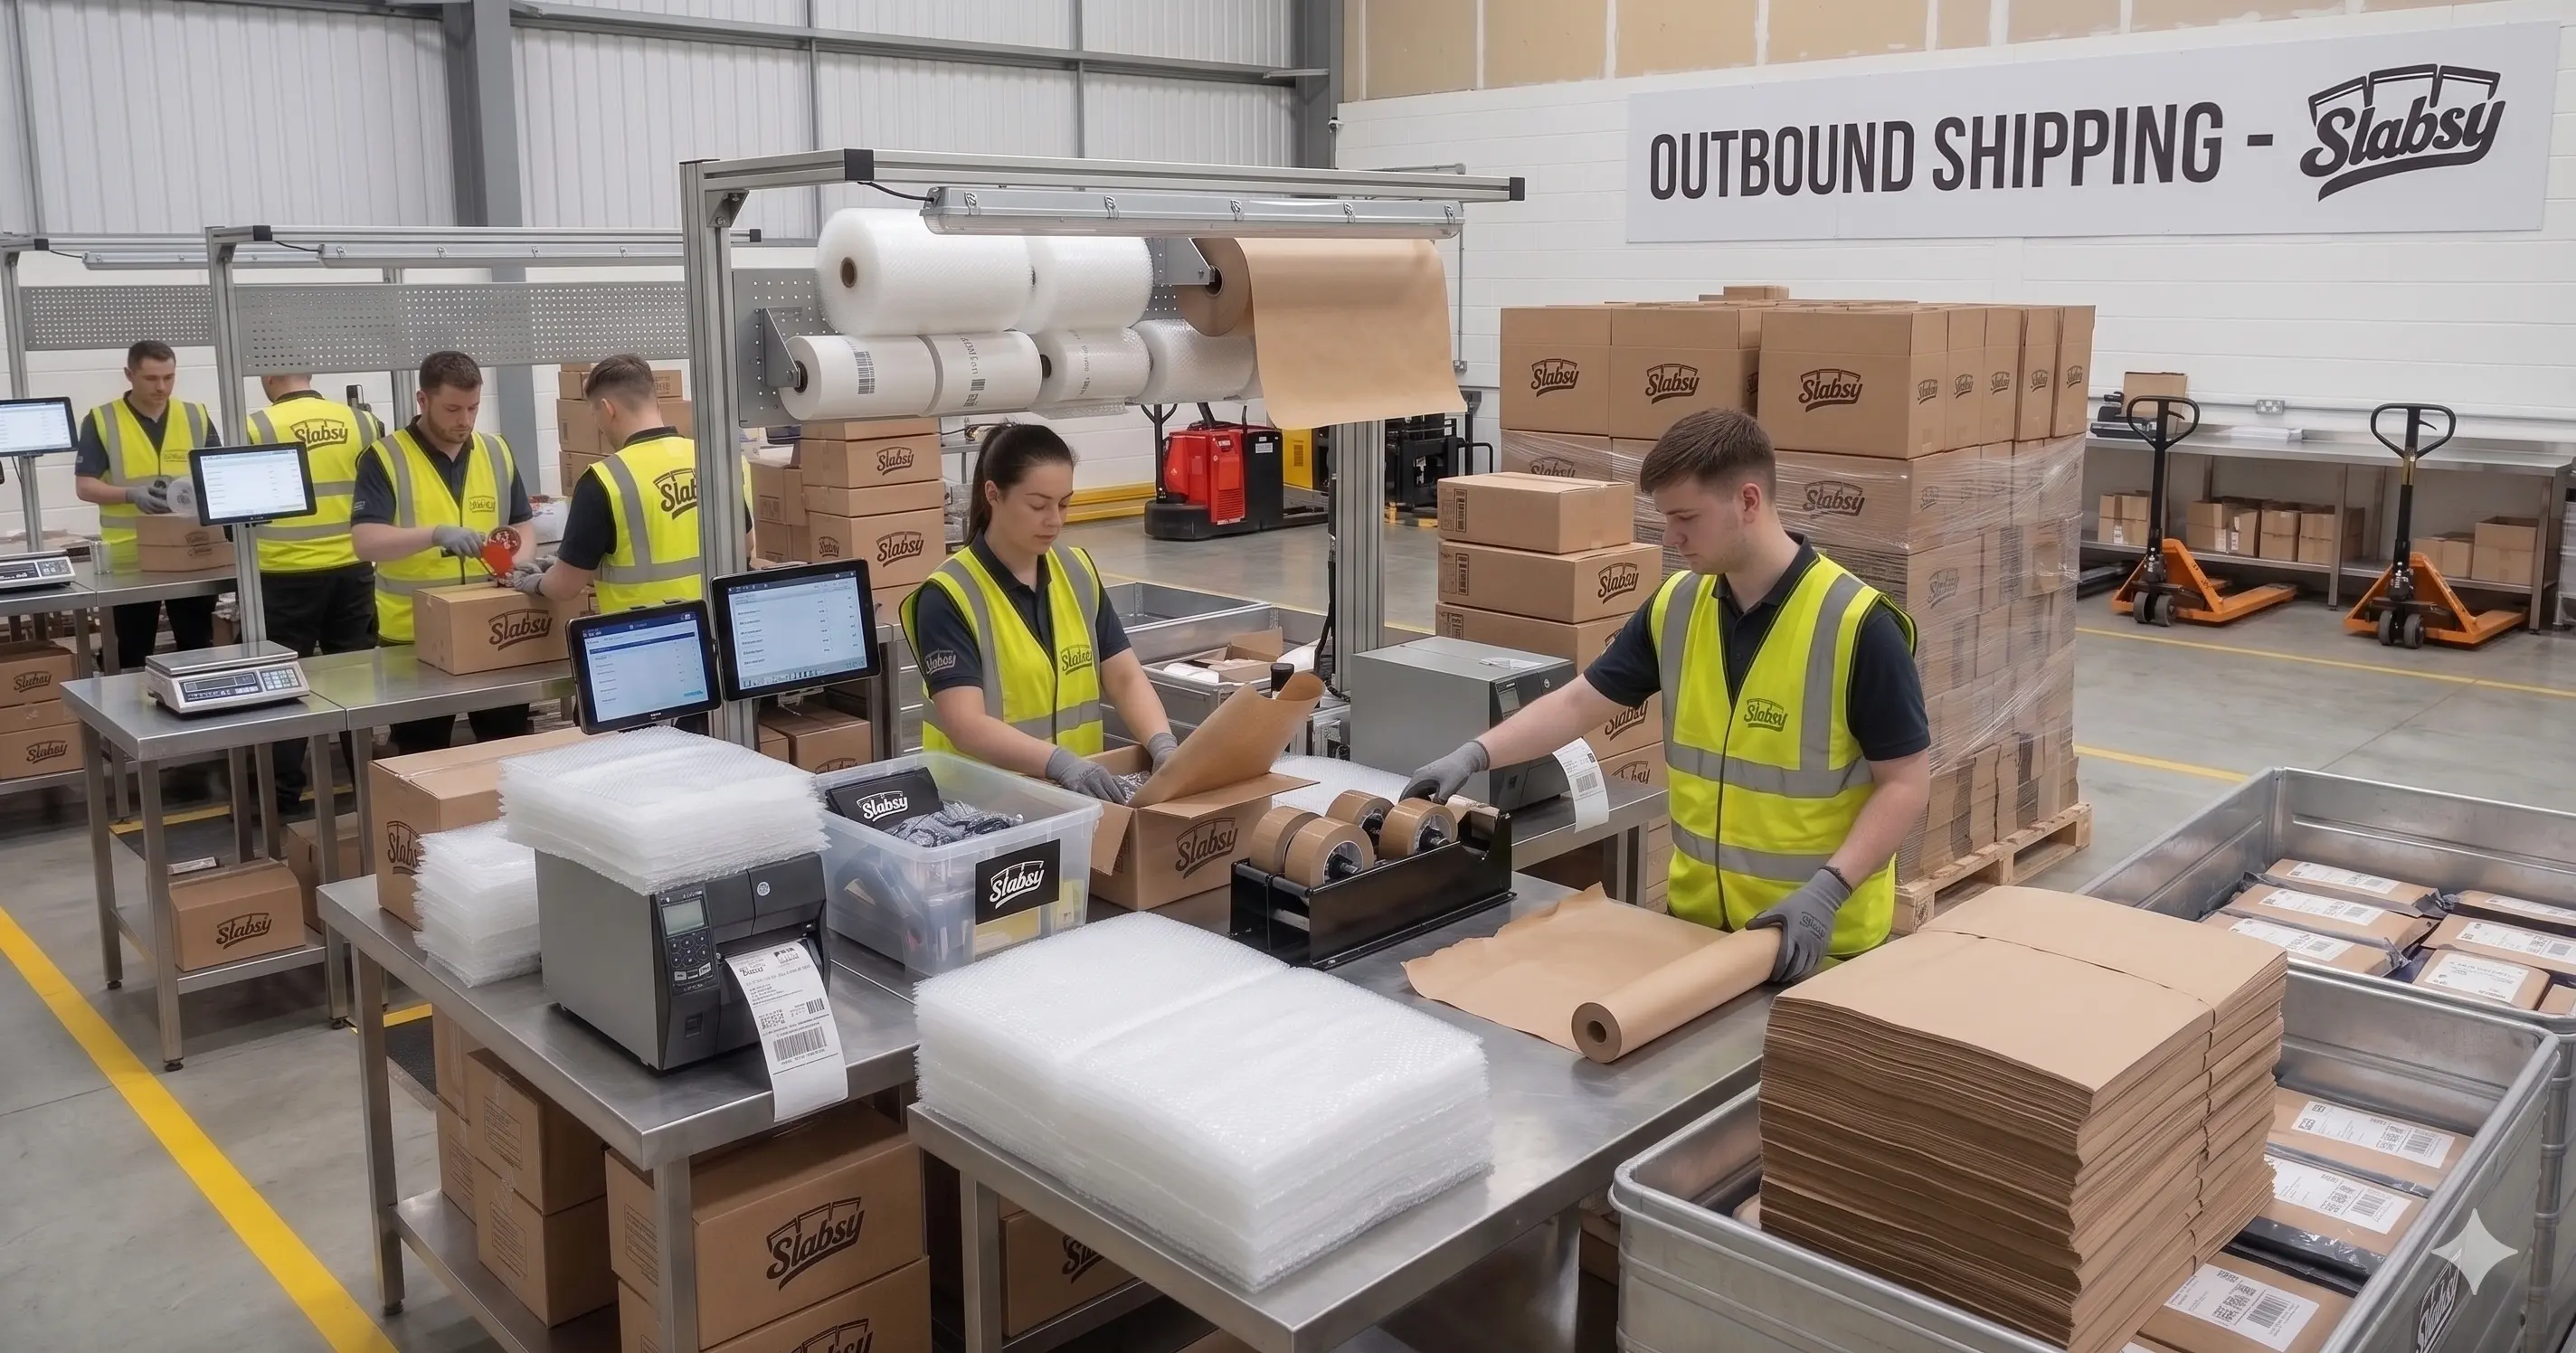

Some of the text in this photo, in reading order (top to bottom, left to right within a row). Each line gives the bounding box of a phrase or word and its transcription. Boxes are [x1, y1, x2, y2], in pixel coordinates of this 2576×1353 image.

[1649, 94, 2506, 203] OUTBOUND SHIPPING - Slabsy
[1530, 368, 1580, 398] Slabsy
[1644, 372, 1700, 405] Slabsy
[1798, 376, 1863, 412] Slabsy
[294, 425, 348, 451] Slabsy
[876, 450, 914, 476] Slabsy
[660, 478, 697, 520] Slab
[1803, 489, 1865, 520] Slabsy
[876, 539, 924, 568] Slabsy
[488, 616, 553, 651] Slabsy
[862, 796, 908, 822] Slabsy
[1175, 828, 1239, 879] Slabsy
[990, 868, 1045, 909] Slabsy
[216, 916, 272, 950] Slabsy
[766, 1209, 865, 1292] Slabsy
